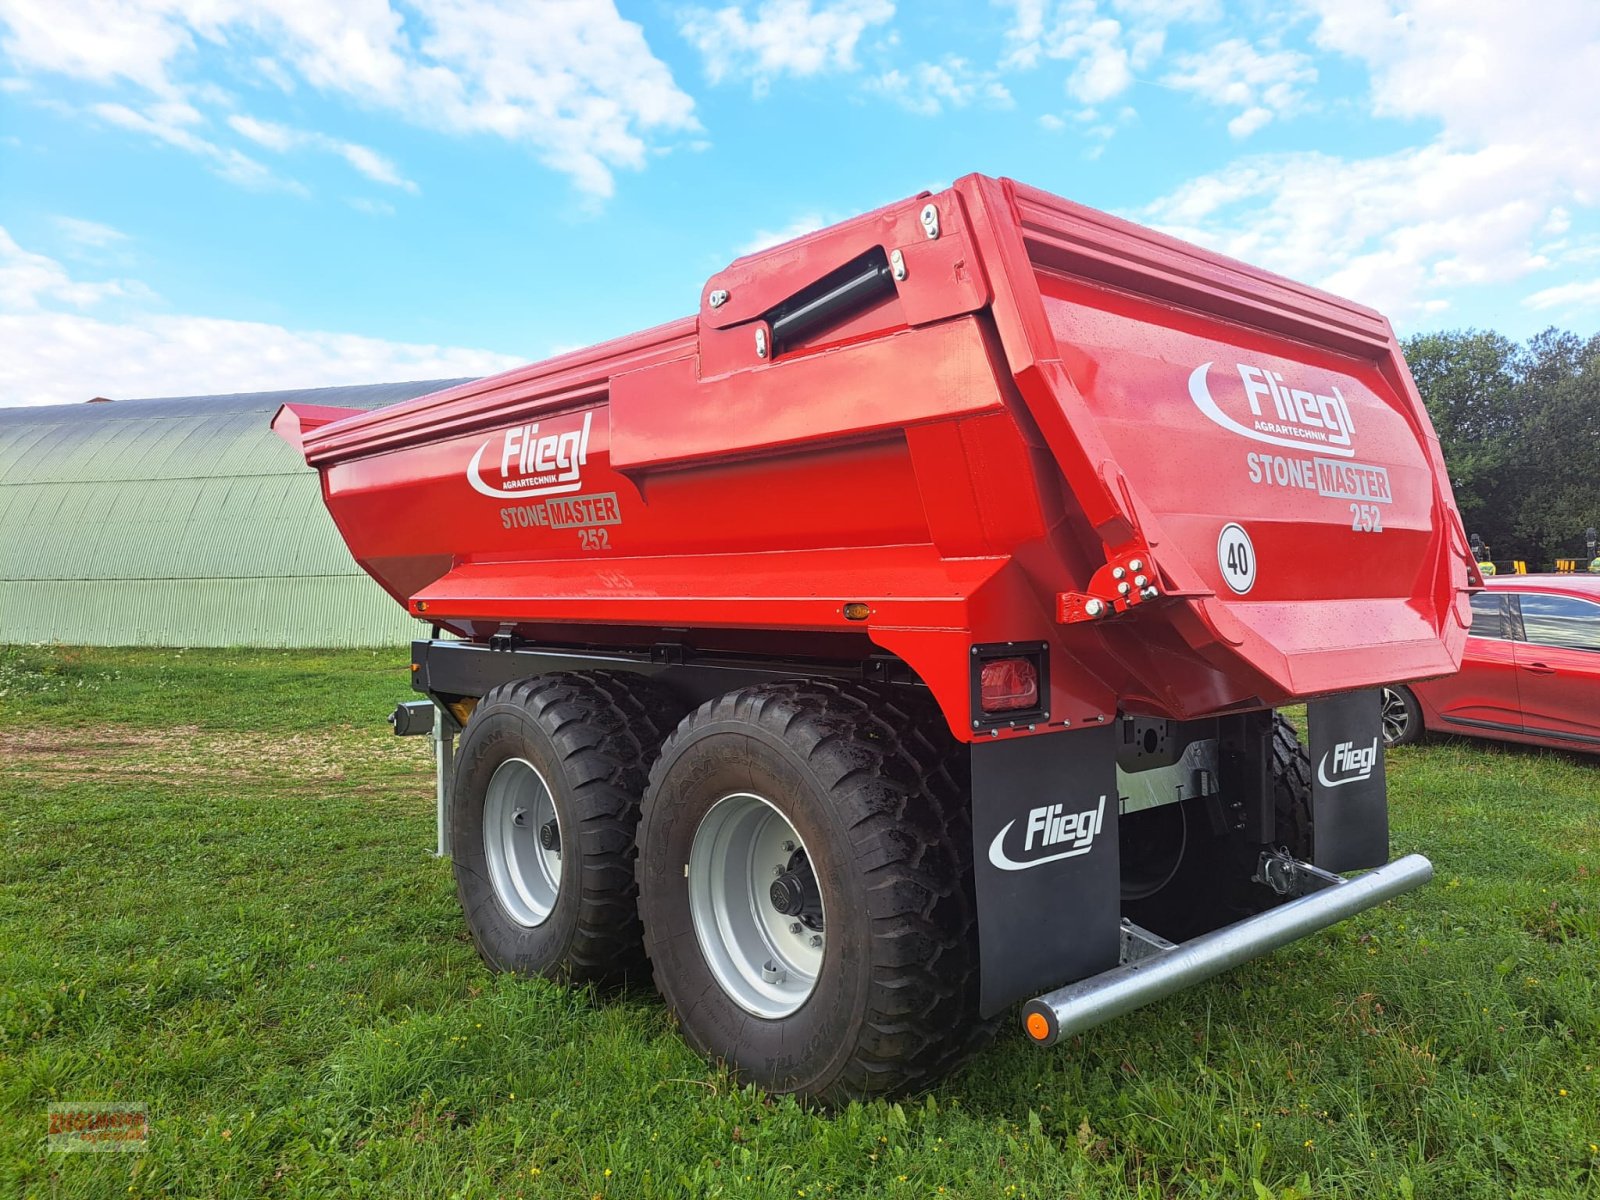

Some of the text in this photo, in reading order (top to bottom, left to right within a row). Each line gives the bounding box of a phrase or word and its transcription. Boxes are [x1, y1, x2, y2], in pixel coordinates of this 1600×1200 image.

[1236, 363, 1356, 446] Fliegl
[501, 411, 593, 482] Fliegl
[1254, 420, 1328, 443] AGRARTECHNIK
[502, 474, 558, 490] AGRARTECHNIK
[1350, 503, 1383, 533] 252
[578, 527, 612, 551] 252
[1227, 542, 1249, 576] 40
[1333, 737, 1378, 775] Fliegl
[1024, 795, 1107, 852] Fliegl
